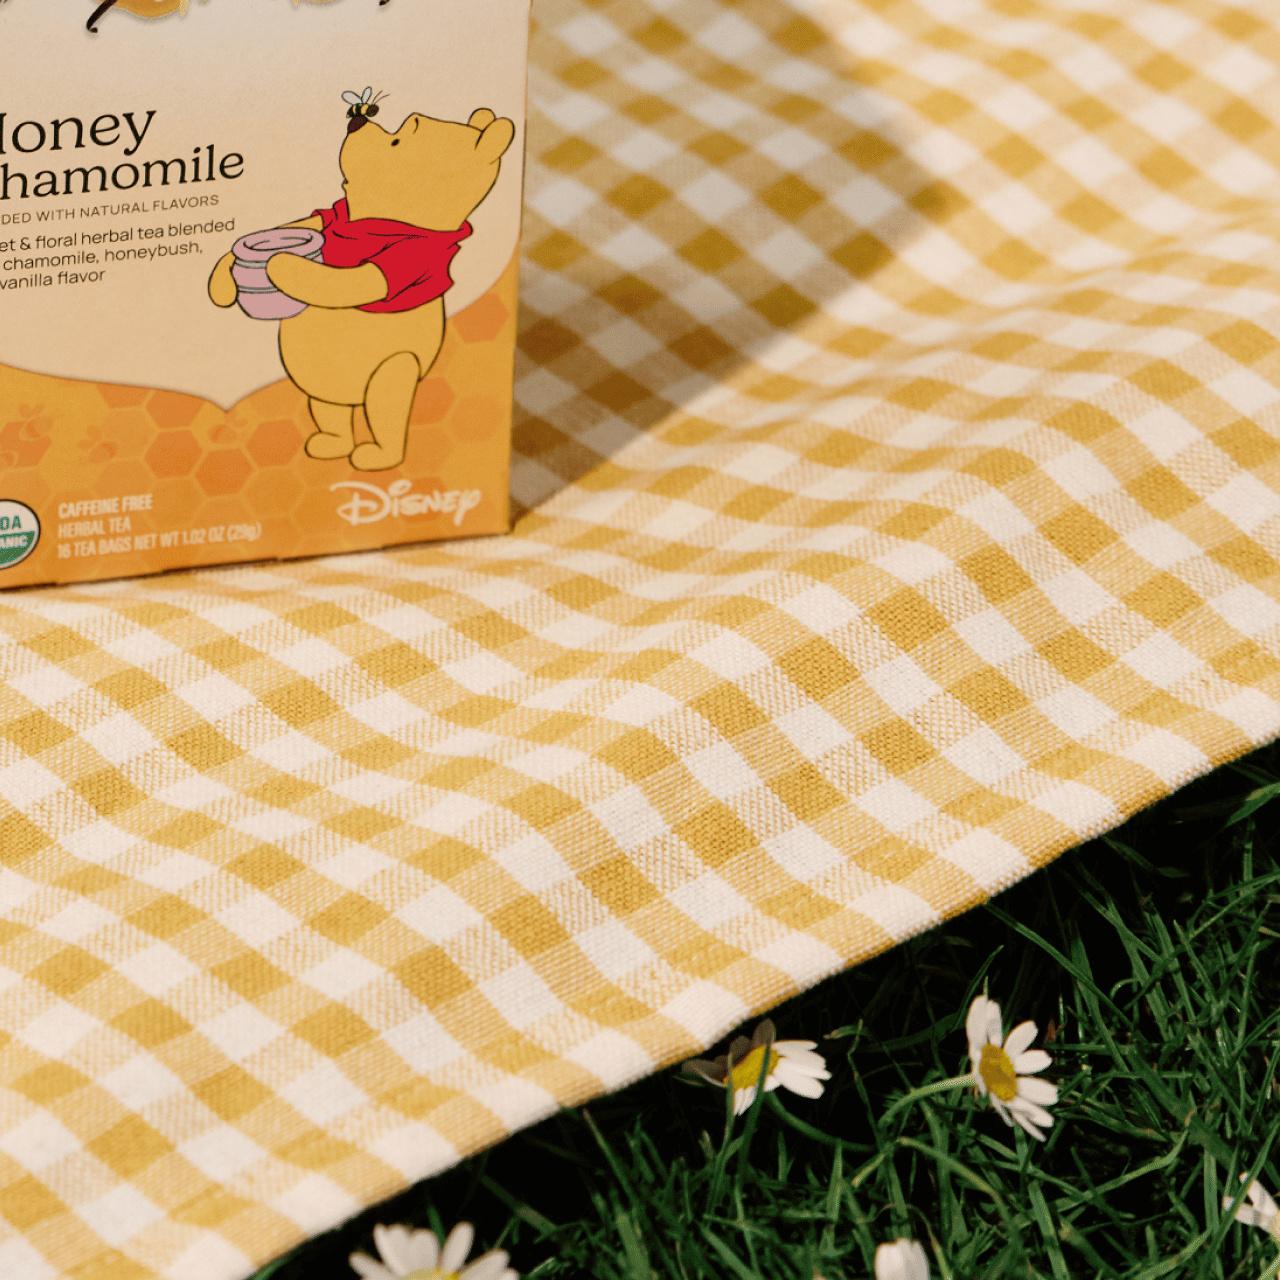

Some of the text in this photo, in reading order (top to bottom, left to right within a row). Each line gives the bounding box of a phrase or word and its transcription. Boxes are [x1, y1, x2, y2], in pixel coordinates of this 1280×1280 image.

[36, 209, 76, 222] WITH
[80, 202, 149, 219] NATURAL
[152, 194, 220, 211] FLAVORS
[20, 237, 31, 250] &
[35, 233, 77, 249] floral
[81, 228, 133, 246] herbal
[137, 227, 164, 240] tea
[168, 218, 235, 236] blended
[3, 251, 99, 271] chamomile,
[105, 241, 203, 262] honeybush,
[0, 274, 53, 290] vanilla
[58, 270, 105, 285] flavor
[58, 494, 153, 519] CAFFEINE FREE
[58, 516, 131, 538] HERBAL TEA
[73, 540, 96, 557] TEA
[99, 536, 132, 554] BAGS
[134, 534, 158, 550] NET
[160, 531, 180, 547] WT
